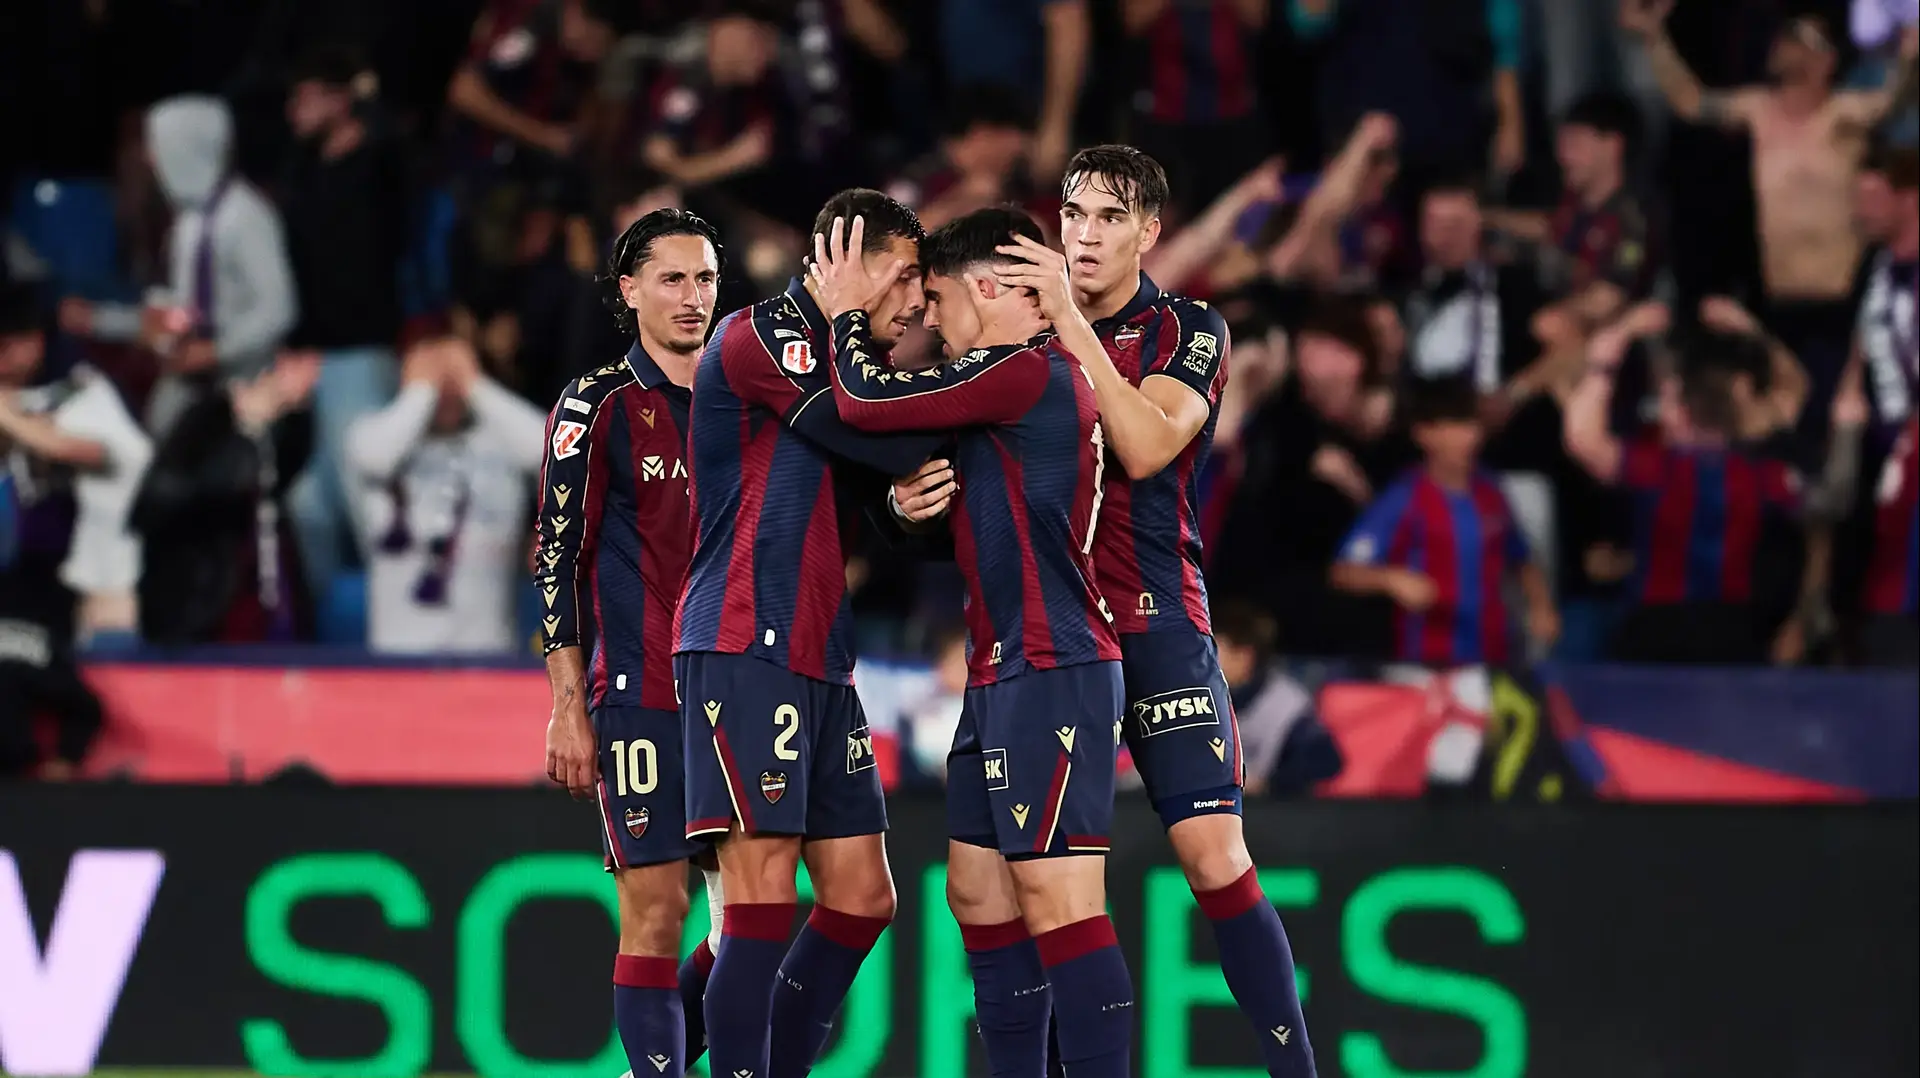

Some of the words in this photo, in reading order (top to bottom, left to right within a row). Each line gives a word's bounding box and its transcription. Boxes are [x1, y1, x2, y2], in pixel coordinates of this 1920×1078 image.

[1151, 696, 1213, 724] JYSK
[774, 703, 799, 760] 2
[854, 735, 873, 759] JY
[610, 738, 658, 796] 10
[984, 758, 1004, 780] SK
